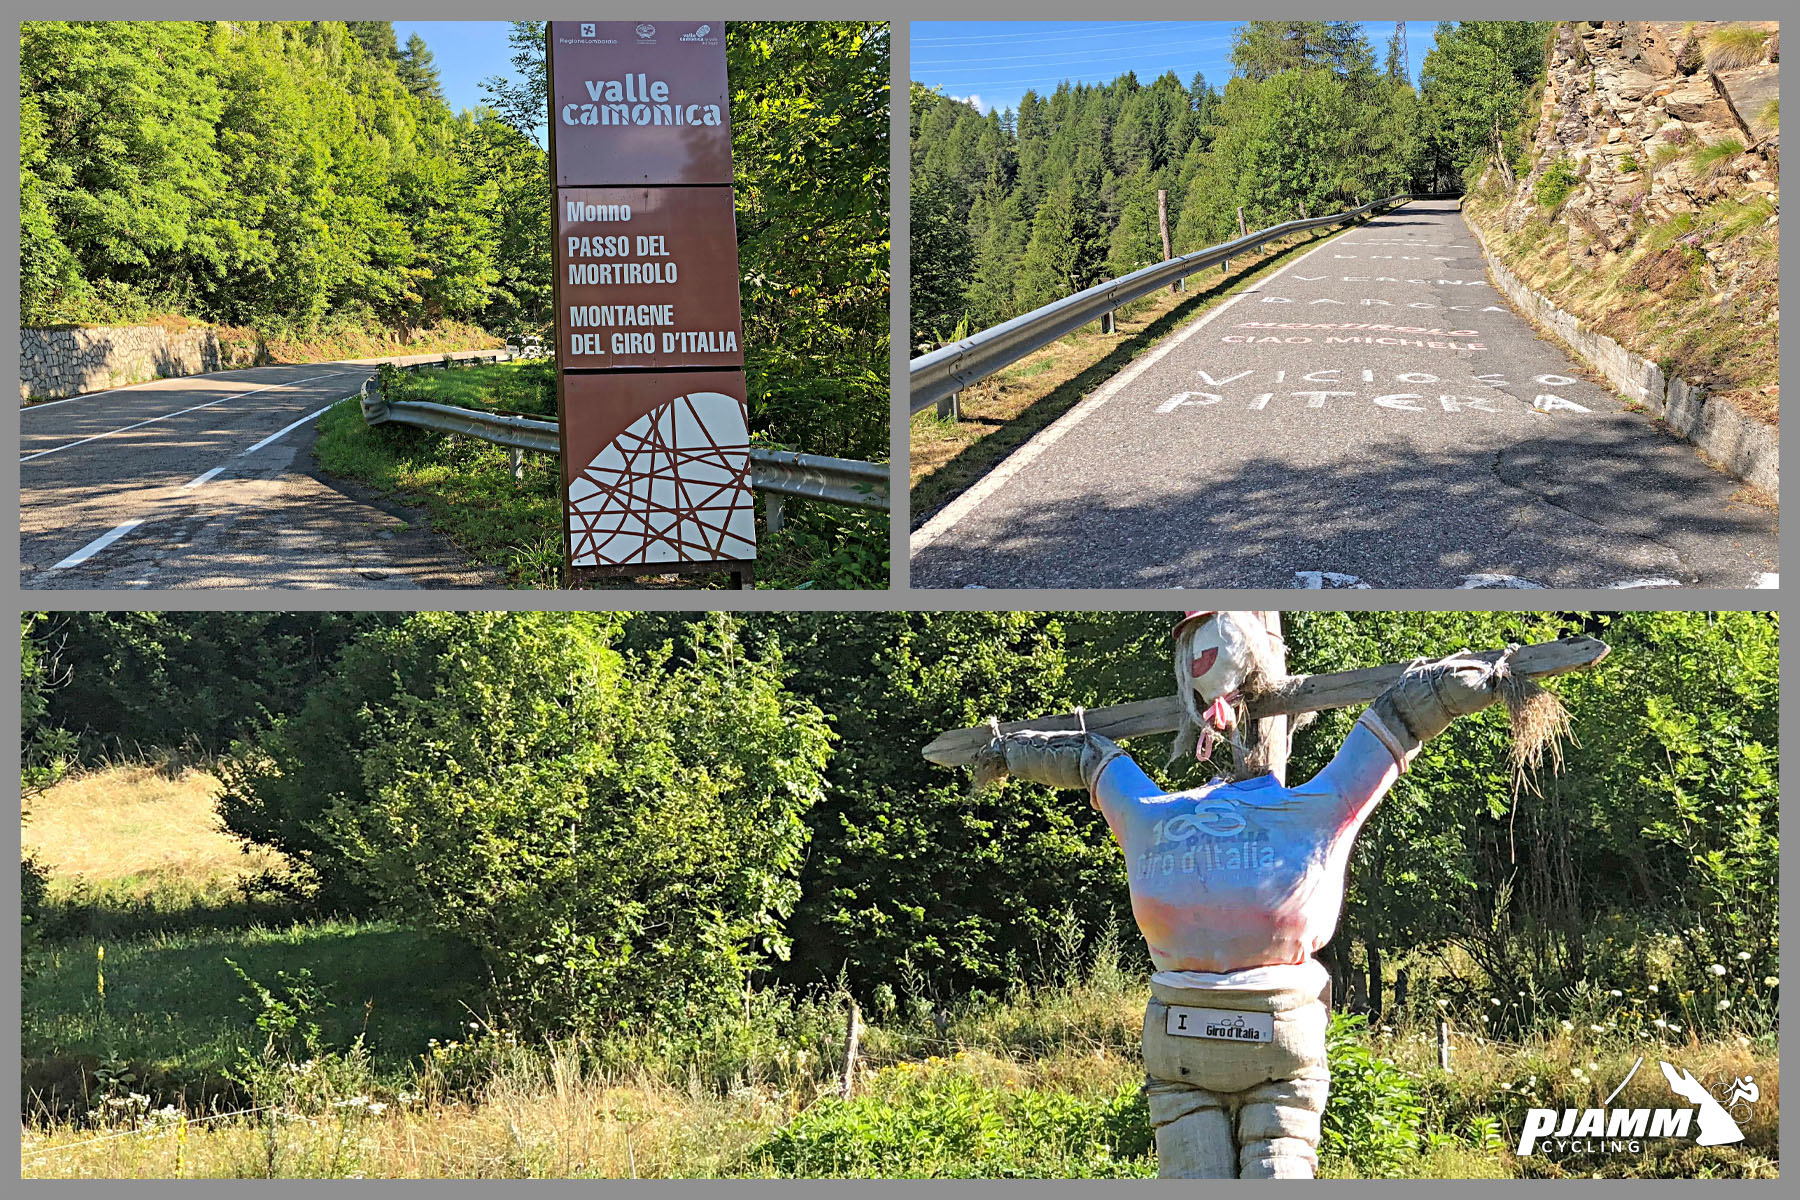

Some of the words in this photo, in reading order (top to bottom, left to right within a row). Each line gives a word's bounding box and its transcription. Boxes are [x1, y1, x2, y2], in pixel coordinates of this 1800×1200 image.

[585, 73, 669, 103] valle
[562, 103, 722, 127] camonica
[567, 201, 631, 222] Monno
[567, 236, 630, 258] PASSO
[636, 235, 670, 257] DEL
[568, 262, 678, 285] MORTIROLO
[570, 304, 675, 328] MONTAGNE
[571, 333, 605, 355] DEL
[611, 332, 656, 355] GIRO
[662, 331, 738, 354] D'ITALIA
[1221, 336, 1313, 344] CIAO
[1325, 336, 1488, 351] MICHELE
[1195, 370, 1578, 388] VICIOSO
[1178, 1014, 1188, 1030] I
[1206, 1025, 1226, 1037] Giro
[1227, 1027, 1260, 1040] d'Italia
